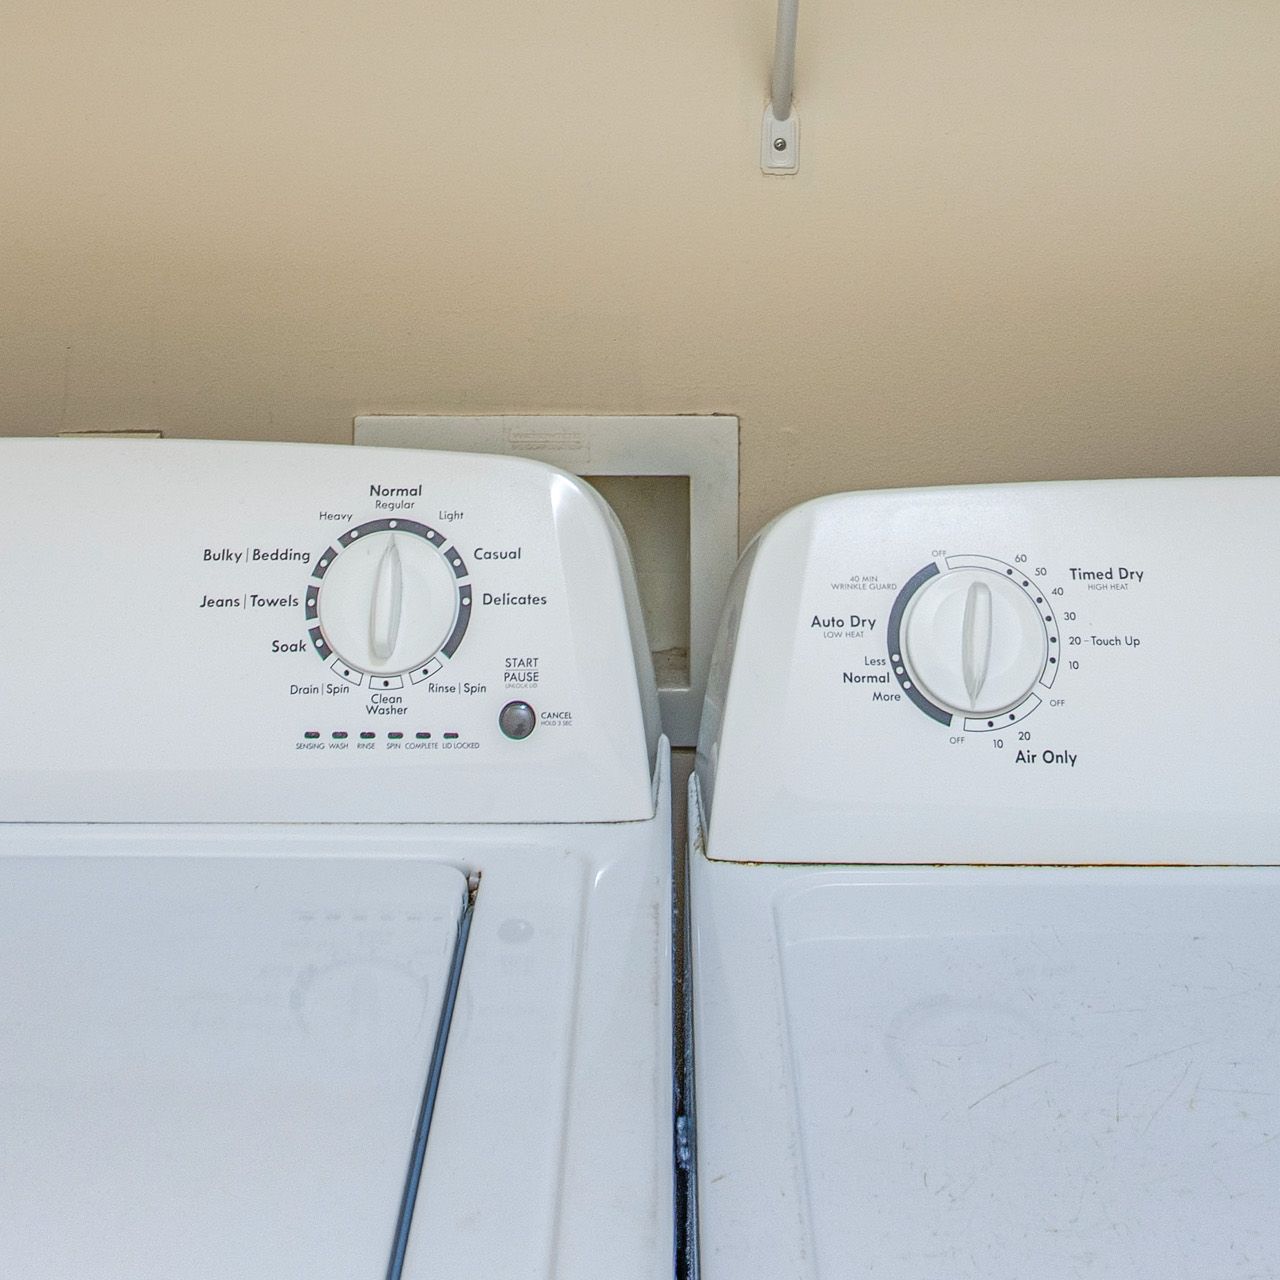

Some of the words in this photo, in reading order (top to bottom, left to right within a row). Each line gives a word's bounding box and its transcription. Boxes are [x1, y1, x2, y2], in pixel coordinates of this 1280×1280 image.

[369, 484, 423, 497] Normal
[375, 499, 415, 512] Regular
[319, 511, 354, 522] Heavy
[438, 510, 464, 523] Light
[203, 548, 243, 564] Bulky
[252, 548, 311, 564] Bedding
[473, 547, 521, 560] Casual
[1014, 554, 1027, 563] 60
[1034, 567, 1047, 577] 50
[1069, 567, 1113, 580] Timed
[1118, 567, 1144, 583] Dry
[1051, 587, 1064, 596] 40
[1087, 583, 1108, 591] HIGH
[199, 595, 241, 608] Jeans
[249, 594, 299, 608] Towels
[482, 592, 548, 606] Delicates
[1063, 611, 1077, 621] 30
[810, 615, 845, 628] Auto
[850, 615, 877, 631] Dry
[823, 631, 843, 639] LOW
[271, 640, 307, 653] Soak
[1068, 636, 1082, 646] 20
[1091, 635, 1122, 646] Touch
[1125, 636, 1141, 648] Up
[505, 657, 539, 668] START
[864, 656, 887, 666] Less
[1068, 660, 1079, 670] 10
[503, 671, 540, 683] PAUSE
[843, 672, 890, 684] Normal
[290, 684, 319, 695] Drain
[326, 683, 350, 696] Spin
[428, 682, 456, 693] Rinse
[463, 682, 487, 695] Spin
[370, 693, 403, 704] Clean
[872, 691, 901, 702] More
[1049, 699, 1065, 707] OFF
[365, 705, 408, 715] Washer
[540, 711, 573, 720] CANCEL
[949, 737, 965, 745] OFF
[1018, 731, 1031, 741] 20
[295, 742, 325, 750] SENSING
[404, 742, 439, 750] COMPLETE
[453, 742, 480, 750] LOCKED
[993, 739, 1004, 749] 10
[1015, 750, 1037, 764] Air
[1042, 750, 1078, 768] Only
